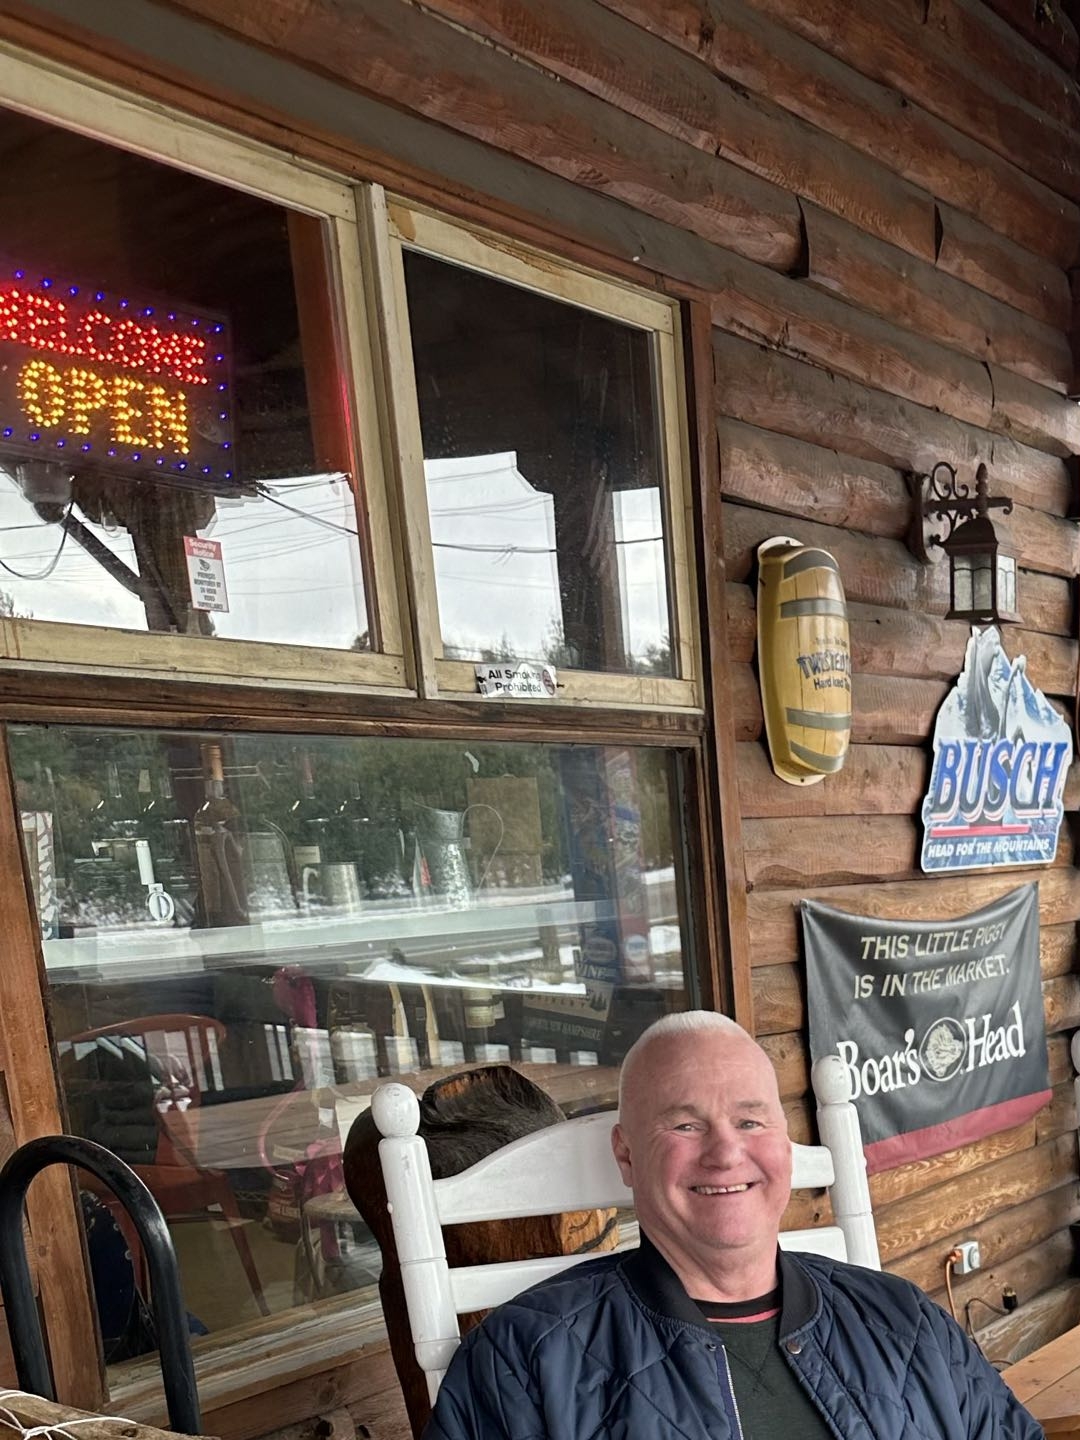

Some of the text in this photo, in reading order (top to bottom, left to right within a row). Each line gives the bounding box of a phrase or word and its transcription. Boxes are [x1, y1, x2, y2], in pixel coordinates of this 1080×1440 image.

[19, 360, 190, 455] OPEN
[488, 670, 502, 679] All
[930, 738, 1068, 818] BUSCH
[928, 844, 954, 858] HEAD
[956, 842, 974, 856] FOR
[976, 841, 993, 854] THE
[860, 919, 1009, 960] THIS LITTLE PIGGY
[854, 954, 1011, 999] IS IN THE MARKET.
[836, 1000, 1026, 1100] Boar's Head
